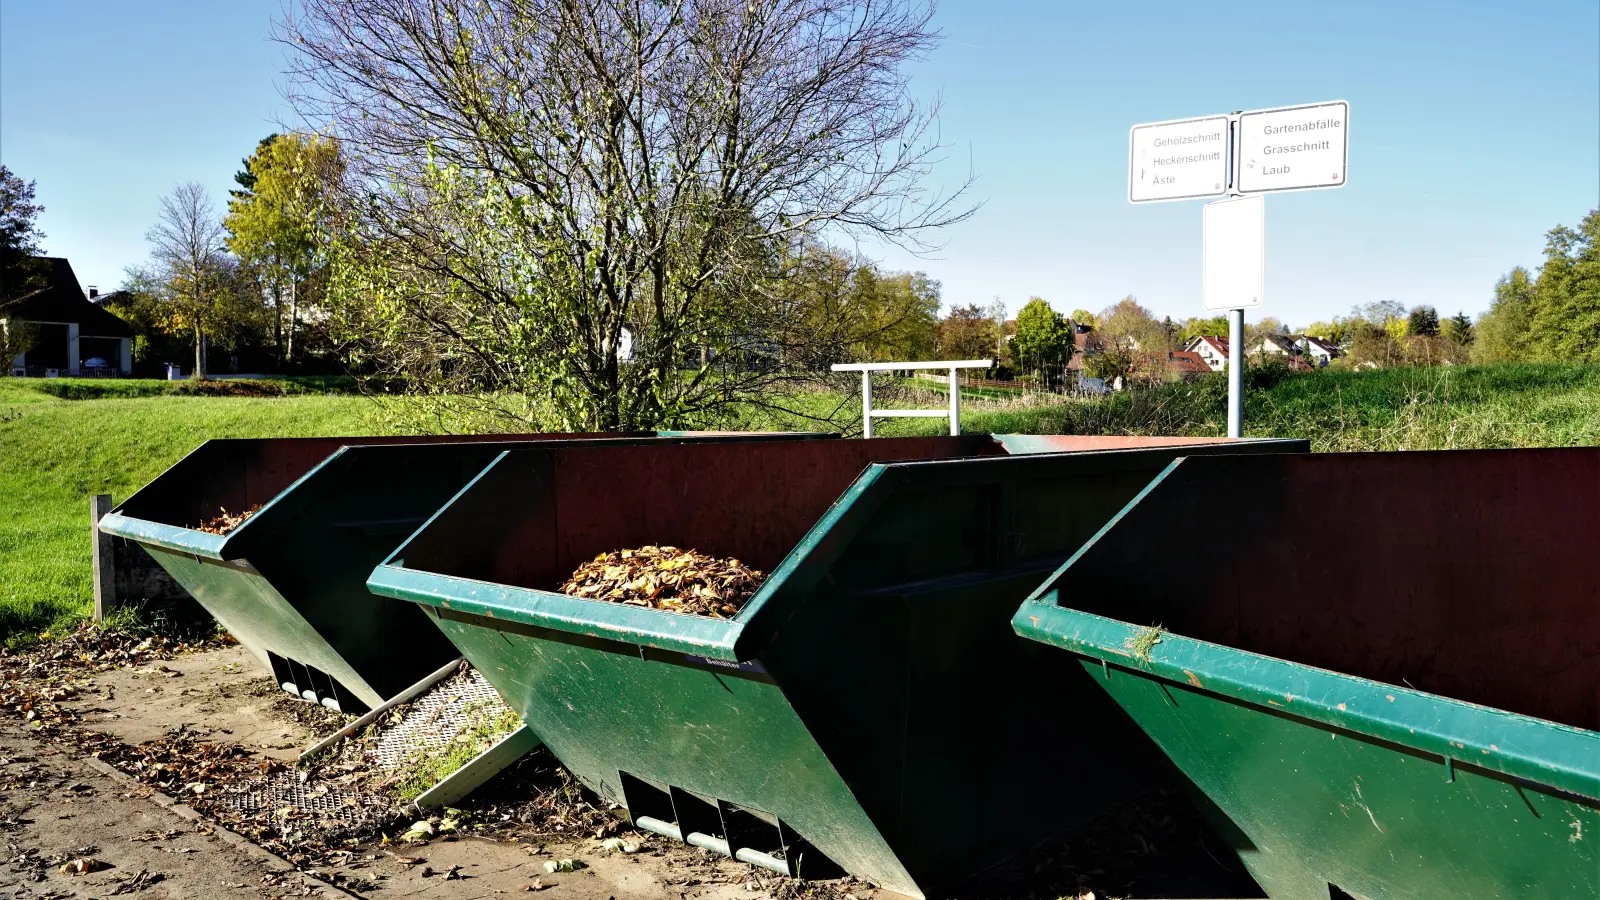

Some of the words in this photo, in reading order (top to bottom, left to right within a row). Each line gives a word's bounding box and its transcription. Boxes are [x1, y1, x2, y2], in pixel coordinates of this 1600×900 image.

[1264, 119, 1340, 135] Gartenabfälle
[1154, 132, 1220, 147] Gehölzschnitt
[1263, 140, 1329, 155] Grasschnitt
[1153, 152, 1220, 166] Heckenschnitt
[1262, 164, 1291, 175] Laub
[1153, 174, 1175, 185] Äste
